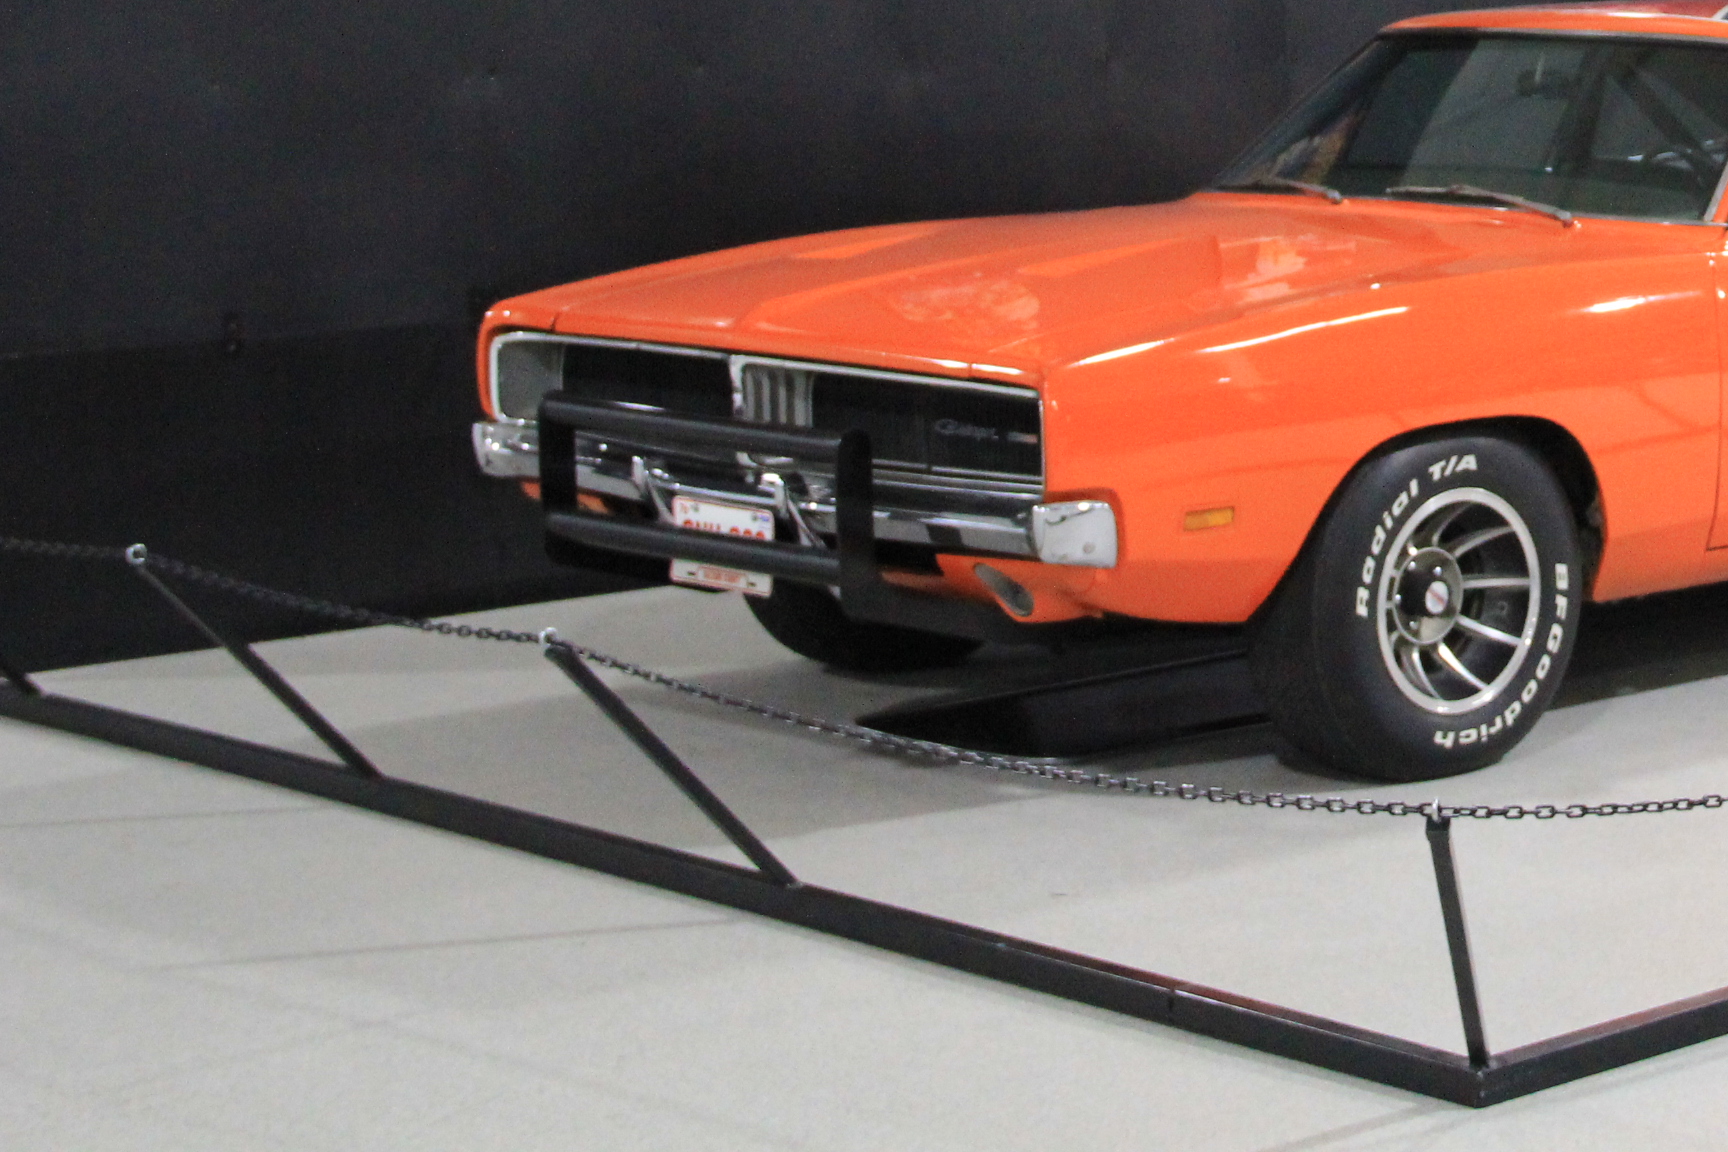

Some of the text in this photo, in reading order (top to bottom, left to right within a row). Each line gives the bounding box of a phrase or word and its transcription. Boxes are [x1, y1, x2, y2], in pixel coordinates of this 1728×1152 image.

[1355, 453, 1478, 618] Radial T/A
[1433, 562, 1569, 748] BFGoodrich
